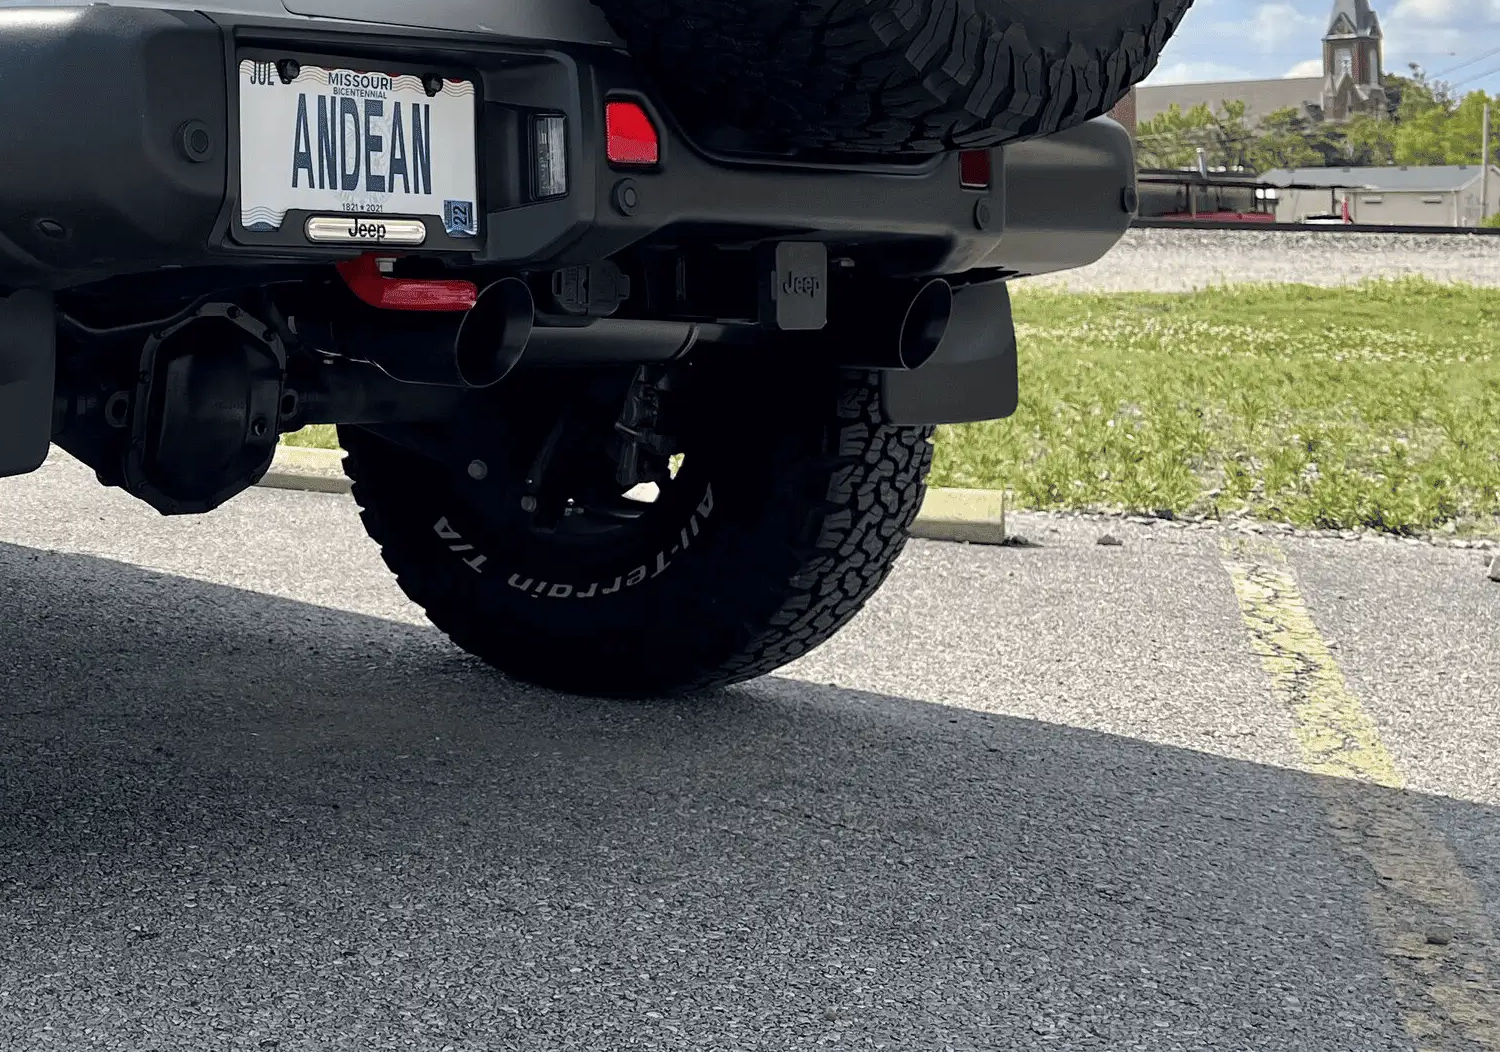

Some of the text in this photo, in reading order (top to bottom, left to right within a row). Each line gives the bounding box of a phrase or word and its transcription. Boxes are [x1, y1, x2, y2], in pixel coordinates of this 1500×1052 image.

[250, 62, 275, 86] JUL
[328, 72, 393, 91] MISSOURI
[333, 86, 387, 99] BICENTENNIAL
[291, 93, 432, 195] ANDEAN
[342, 202, 383, 212] 1821 2021
[453, 205, 467, 225] 22
[349, 219, 387, 242] Jeep
[783, 270, 820, 298] Jeep
[433, 482, 714, 598] All-Terrain T/A
